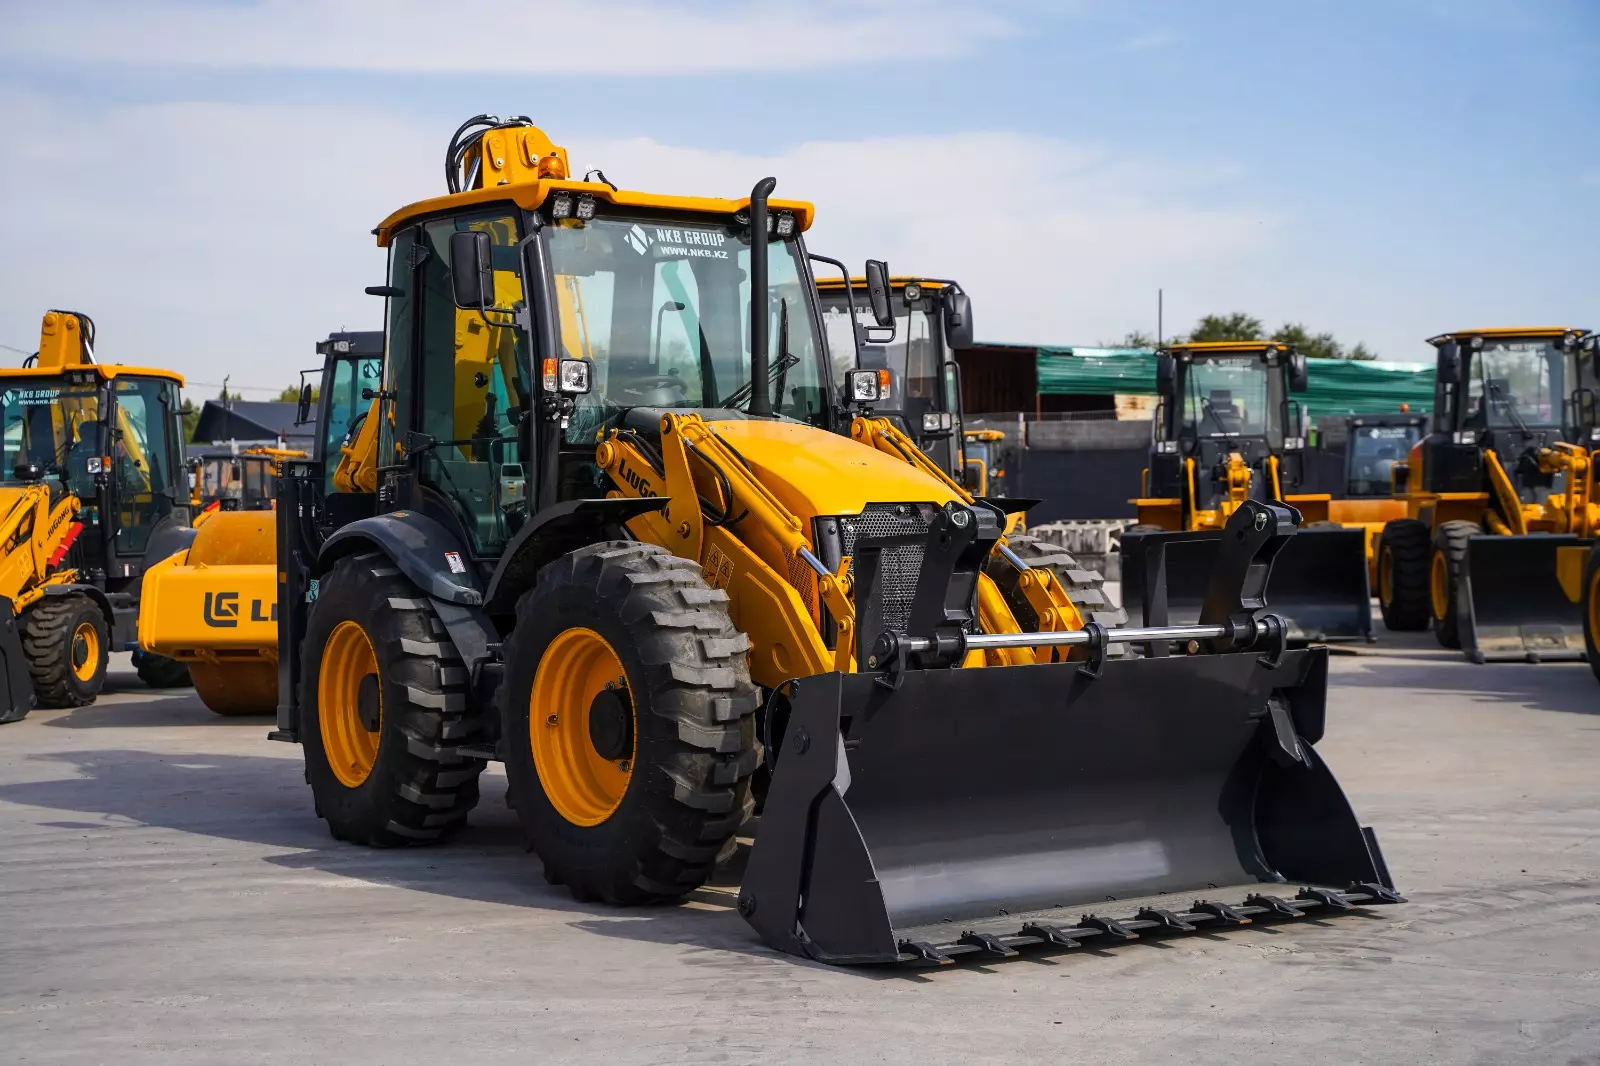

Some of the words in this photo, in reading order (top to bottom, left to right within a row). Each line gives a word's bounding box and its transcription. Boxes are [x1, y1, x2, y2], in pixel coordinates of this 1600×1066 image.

[656, 228, 682, 244] NKB
[684, 230, 725, 247] GROUP
[660, 246, 729, 259] WWW.NKB.KZ
[35, 389, 60, 399] GROUP
